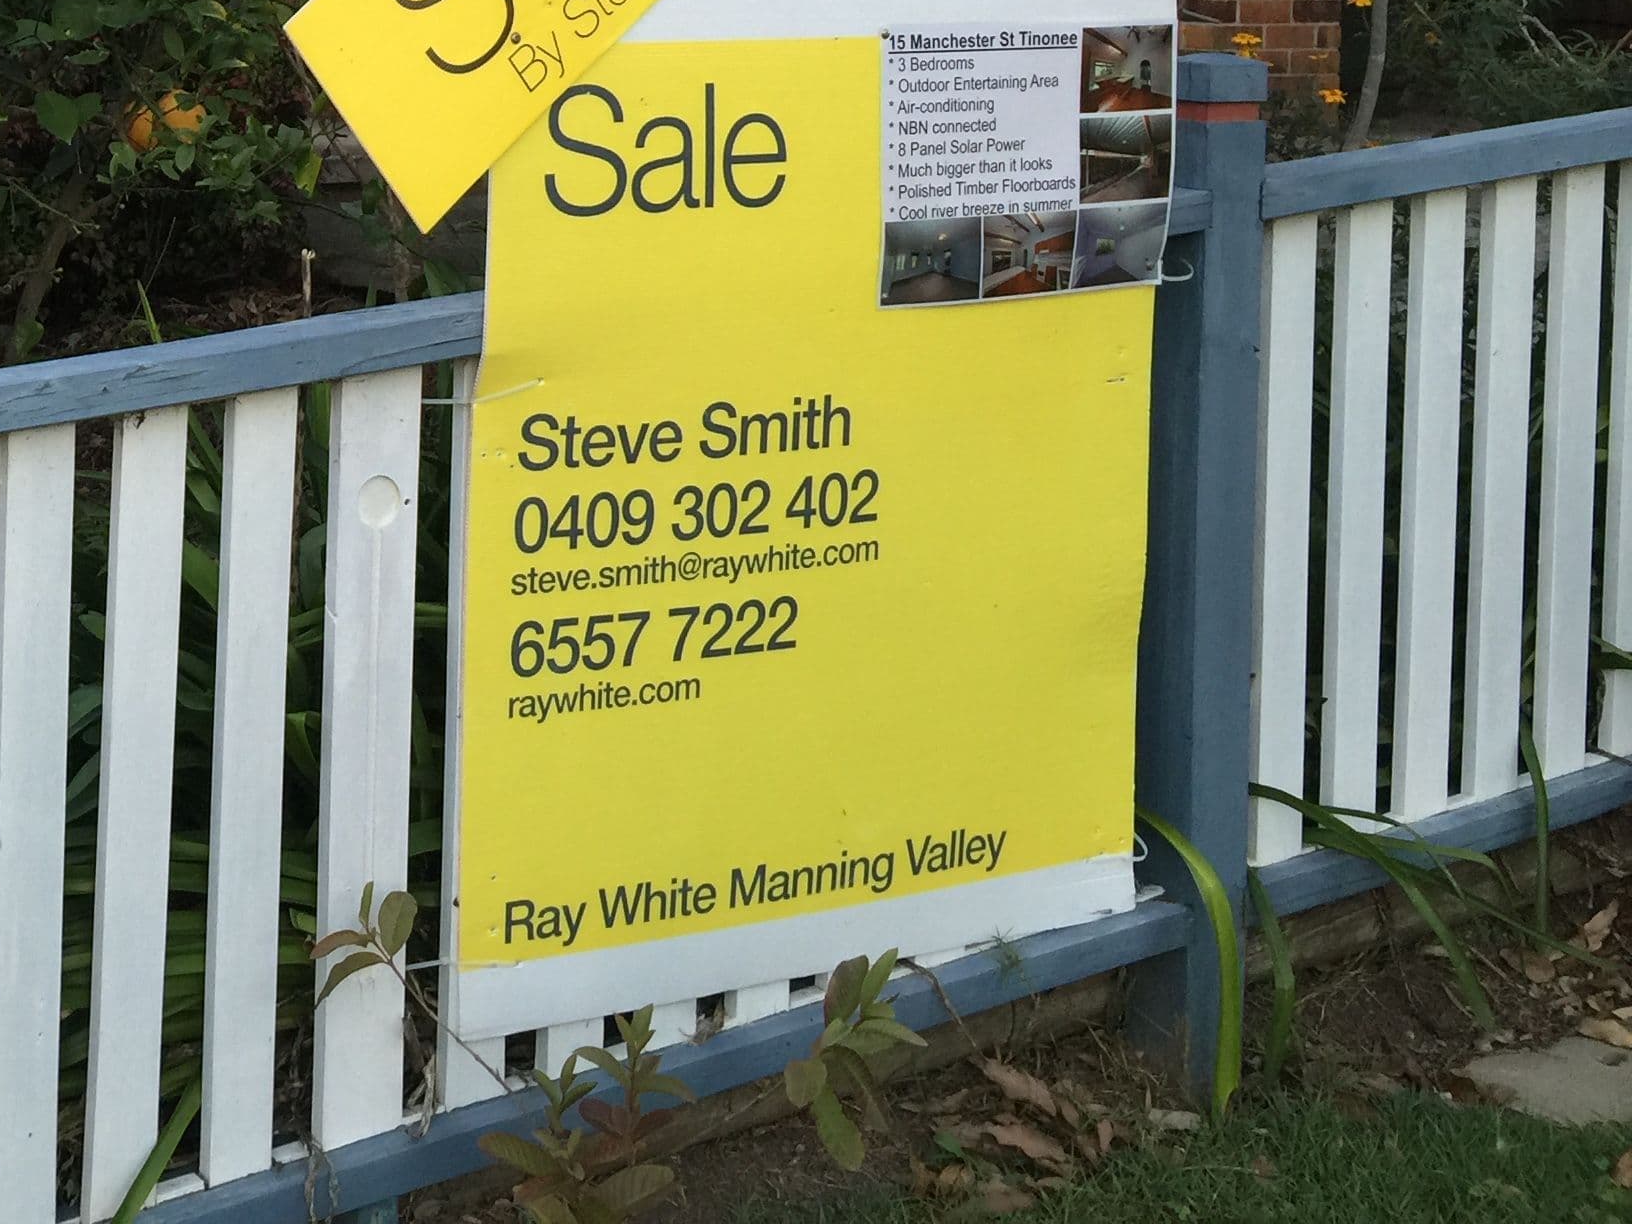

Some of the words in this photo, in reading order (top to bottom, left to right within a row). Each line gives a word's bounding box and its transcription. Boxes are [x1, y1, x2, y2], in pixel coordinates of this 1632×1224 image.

[889, 34, 905, 49] 15
[911, 32, 996, 49] Manchester
[1000, 32, 1015, 47] St
[1019, 29, 1078, 46] Tinonee
[509, 31, 566, 93] By
[898, 59, 907, 72] 3
[910, 57, 975, 72] Bedrooms
[898, 77, 950, 93] Outdoor
[954, 75, 1028, 92] Entertaining
[1030, 74, 1059, 89] Area
[897, 98, 995, 114] Air-conditioning
[898, 120, 928, 135] NBN
[932, 118, 997, 134] connected
[544, 82, 787, 217] Sale
[898, 143, 907, 157] 8
[910, 140, 946, 156] Panel
[950, 139, 983, 154] Solar
[986, 137, 1026, 153] Power
[898, 162, 933, 178] Much
[936, 160, 976, 180] bigger
[979, 159, 1006, 174] than
[1009, 158, 1017, 172] it
[1020, 157, 1053, 172] looks
[898, 182, 953, 199] Polished
[956, 180, 999, 196] Timber
[1002, 176, 1076, 194] Floorboards
[899, 204, 929, 221] Cool
[931, 202, 959, 219] river
[962, 201, 1005, 217] breeze
[1008, 200, 1019, 214] in
[1023, 198, 1073, 214] summer
[518, 412, 683, 472] Steve
[699, 394, 852, 459] Smith
[514, 487, 654, 554] 0409
[670, 479, 770, 542] 302
[785, 468, 879, 530] 402
[511, 535, 879, 596] steve.smith@raywhite.com
[511, 610, 651, 678] 6557
[667, 594, 798, 662] 7222
[507, 677, 701, 723] raywhite.com
[504, 899, 585, 946] Ray
[598, 870, 716, 929] White
[730, 848, 894, 908] Manning
[905, 827, 1007, 876] Valley
